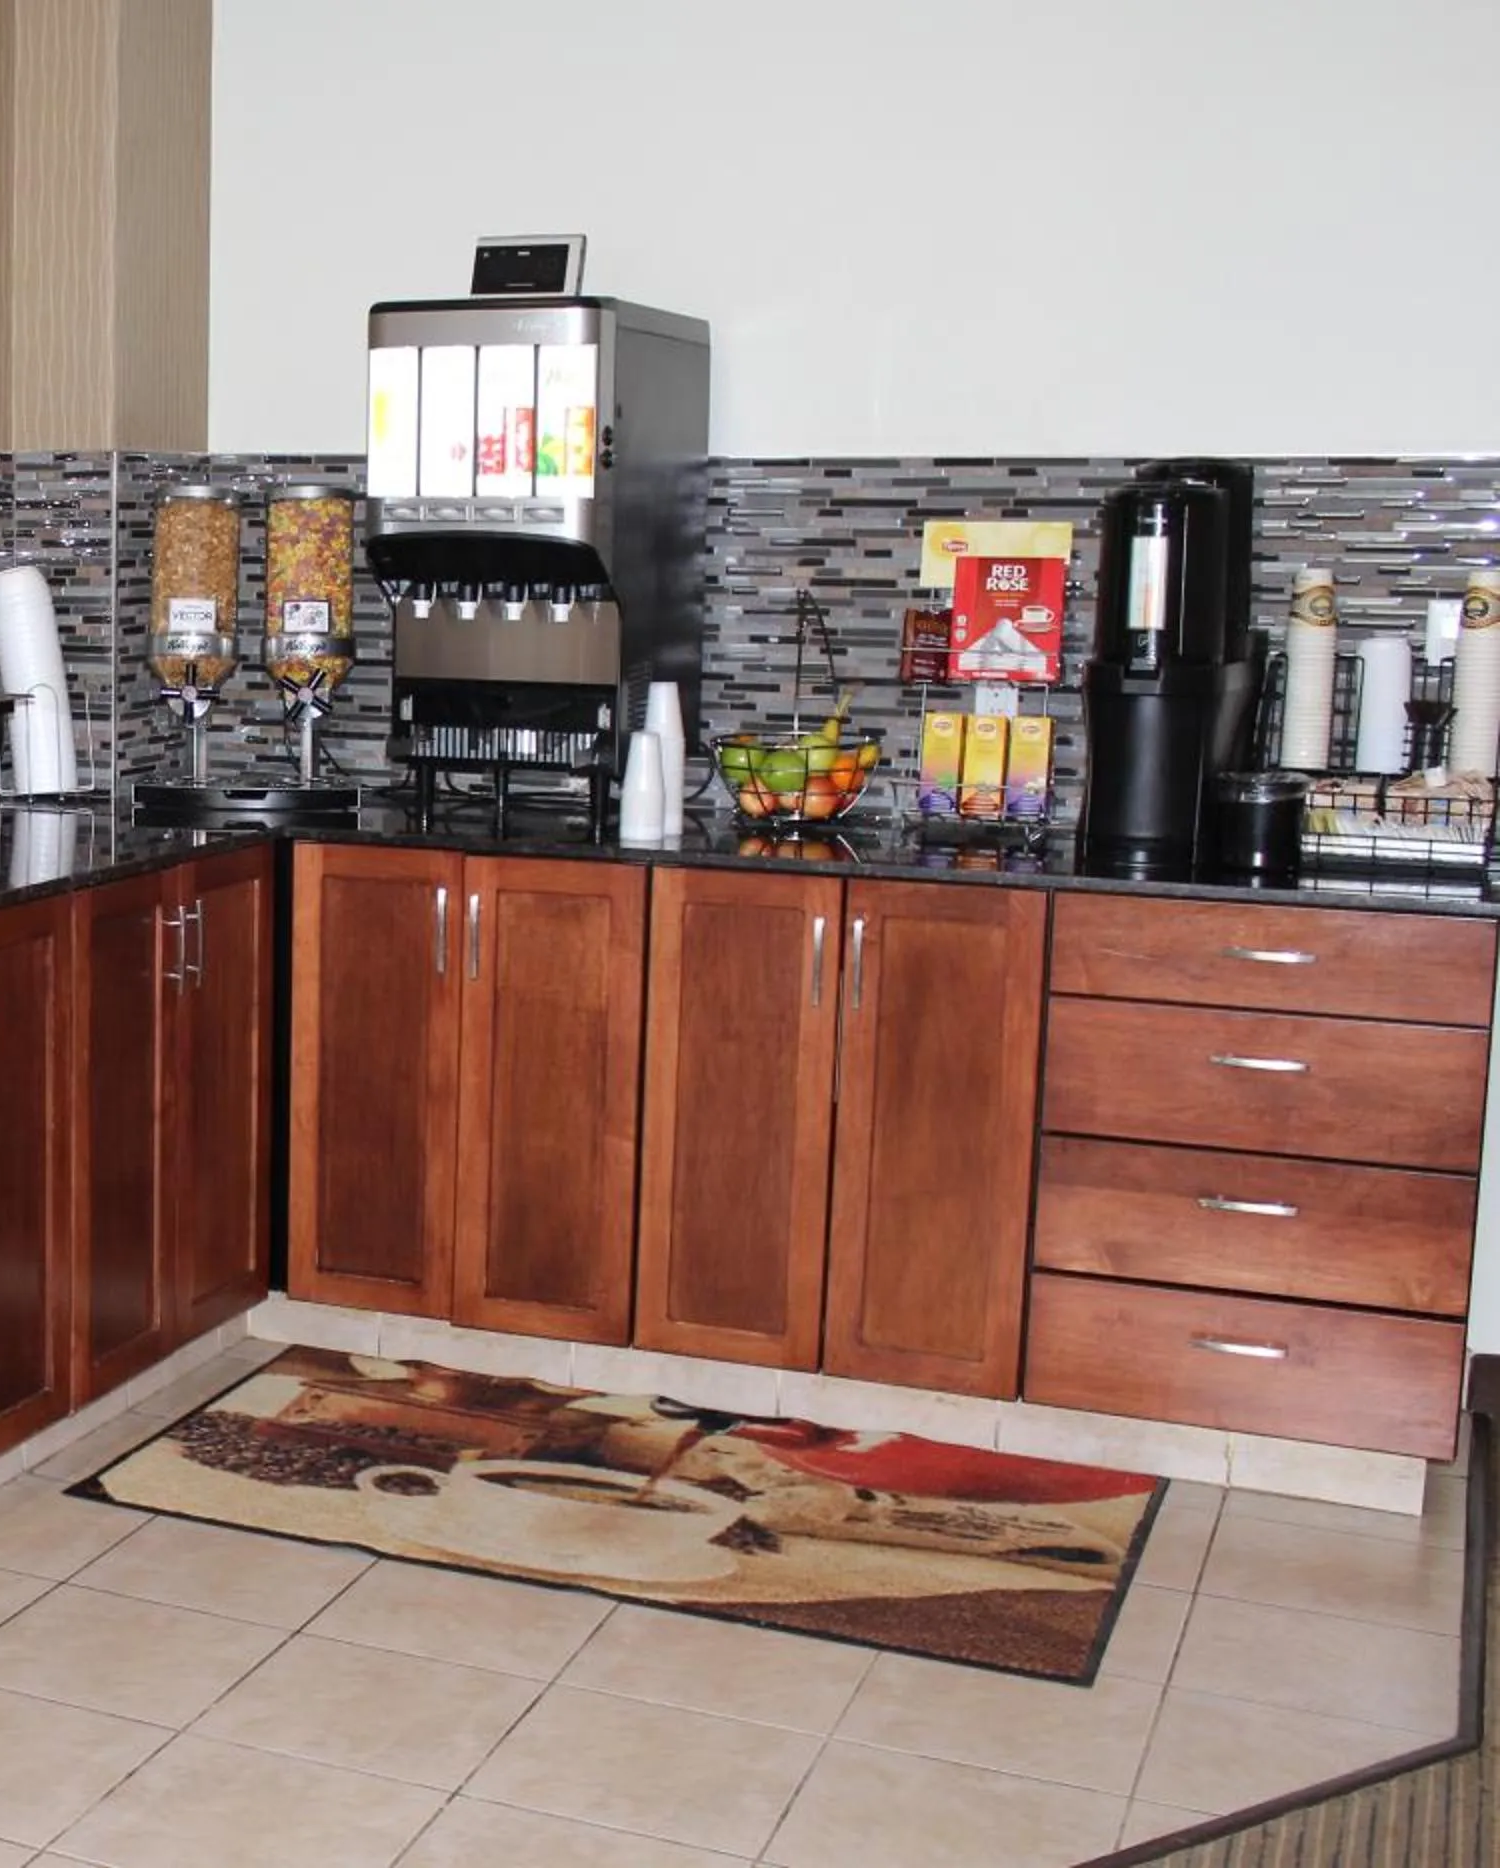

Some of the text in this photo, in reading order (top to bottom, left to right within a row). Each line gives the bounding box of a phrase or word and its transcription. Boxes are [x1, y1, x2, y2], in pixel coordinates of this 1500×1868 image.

[990, 564, 1027, 578] RED
[985, 577, 1029, 591] ROSE
[172, 610, 213, 621] VECTOR
